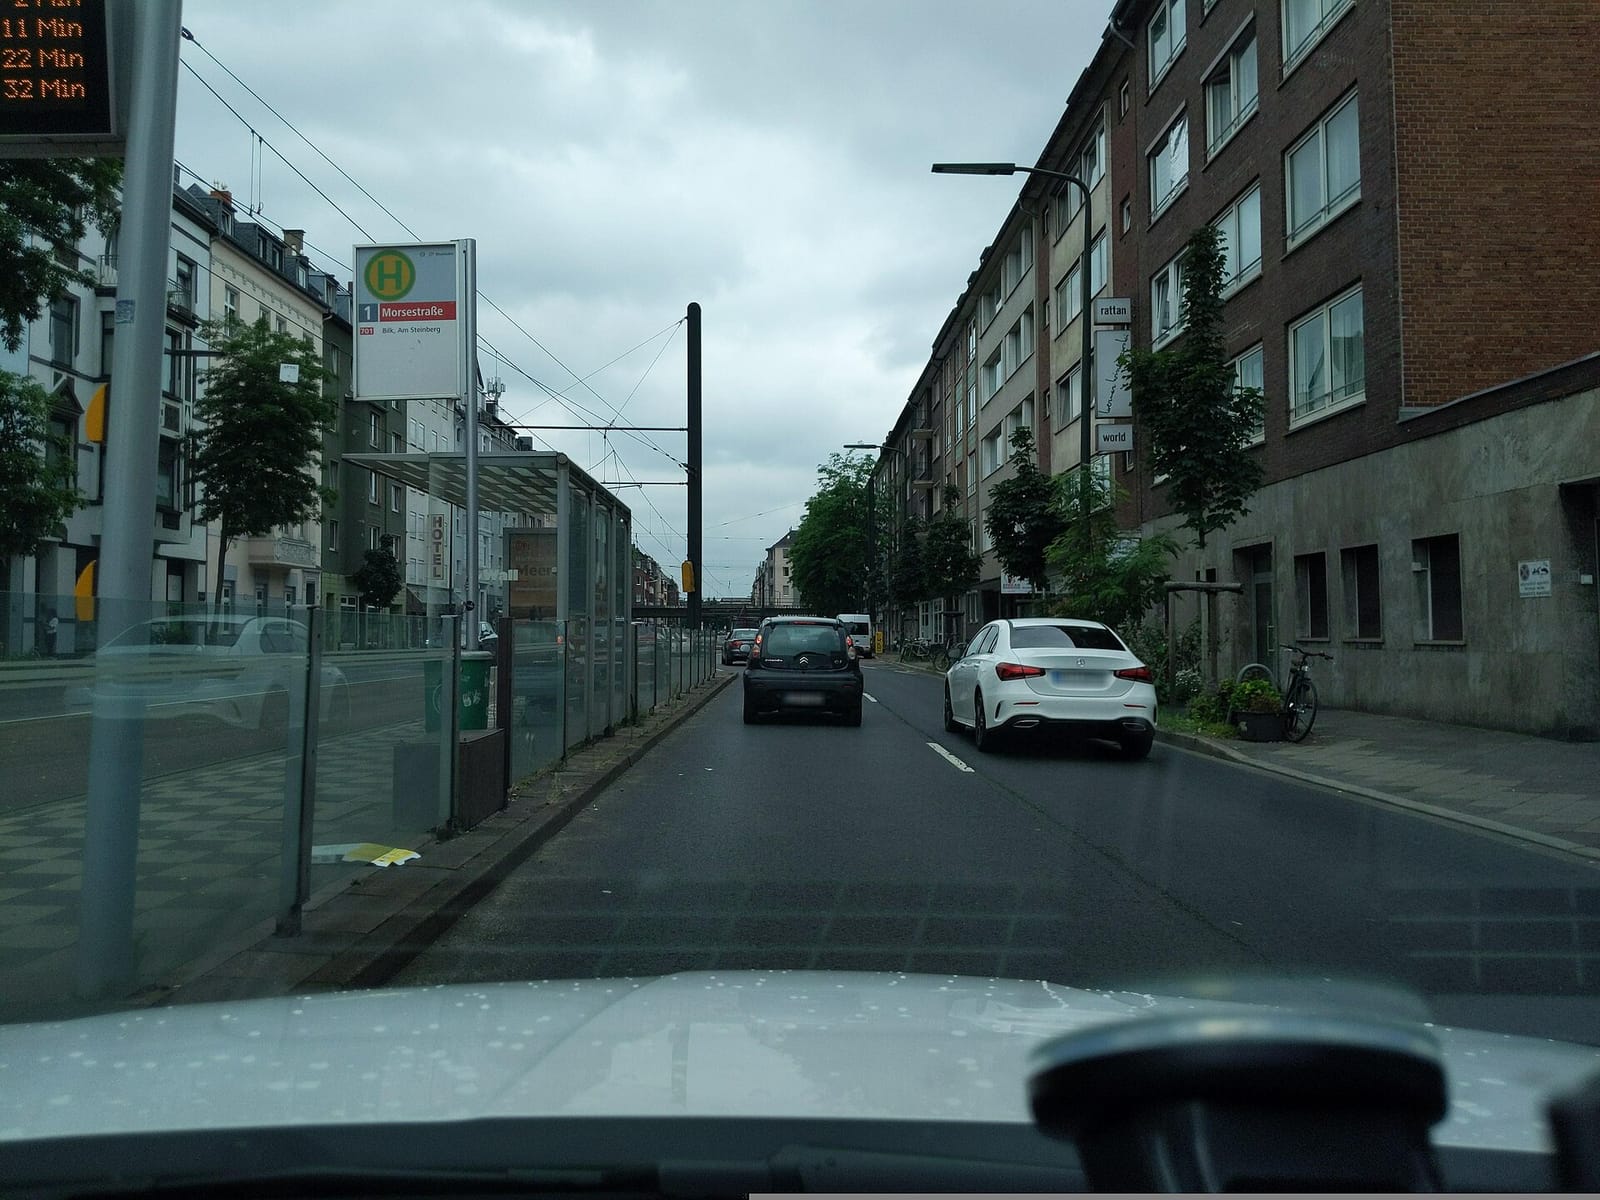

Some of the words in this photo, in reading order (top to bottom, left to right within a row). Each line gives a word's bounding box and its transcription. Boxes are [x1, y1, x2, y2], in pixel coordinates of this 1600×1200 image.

[3, 18, 28, 38] 11
[37, 18, 83, 38] Min
[3, 48, 32, 68] 22
[39, 48, 84, 68] Min
[4, 79, 34, 98] 32
[40, 79, 86, 98] Min
[377, 260, 403, 291] H
[364, 305, 371, 320] 1
[382, 305, 444, 318] Morsestraße
[1100, 305, 1127, 316] rattan
[360, 327, 374, 335] 701
[410, 326, 441, 334] Steinberg
[1102, 431, 1126, 443] world
[432, 515, 443, 578] HOTEL
